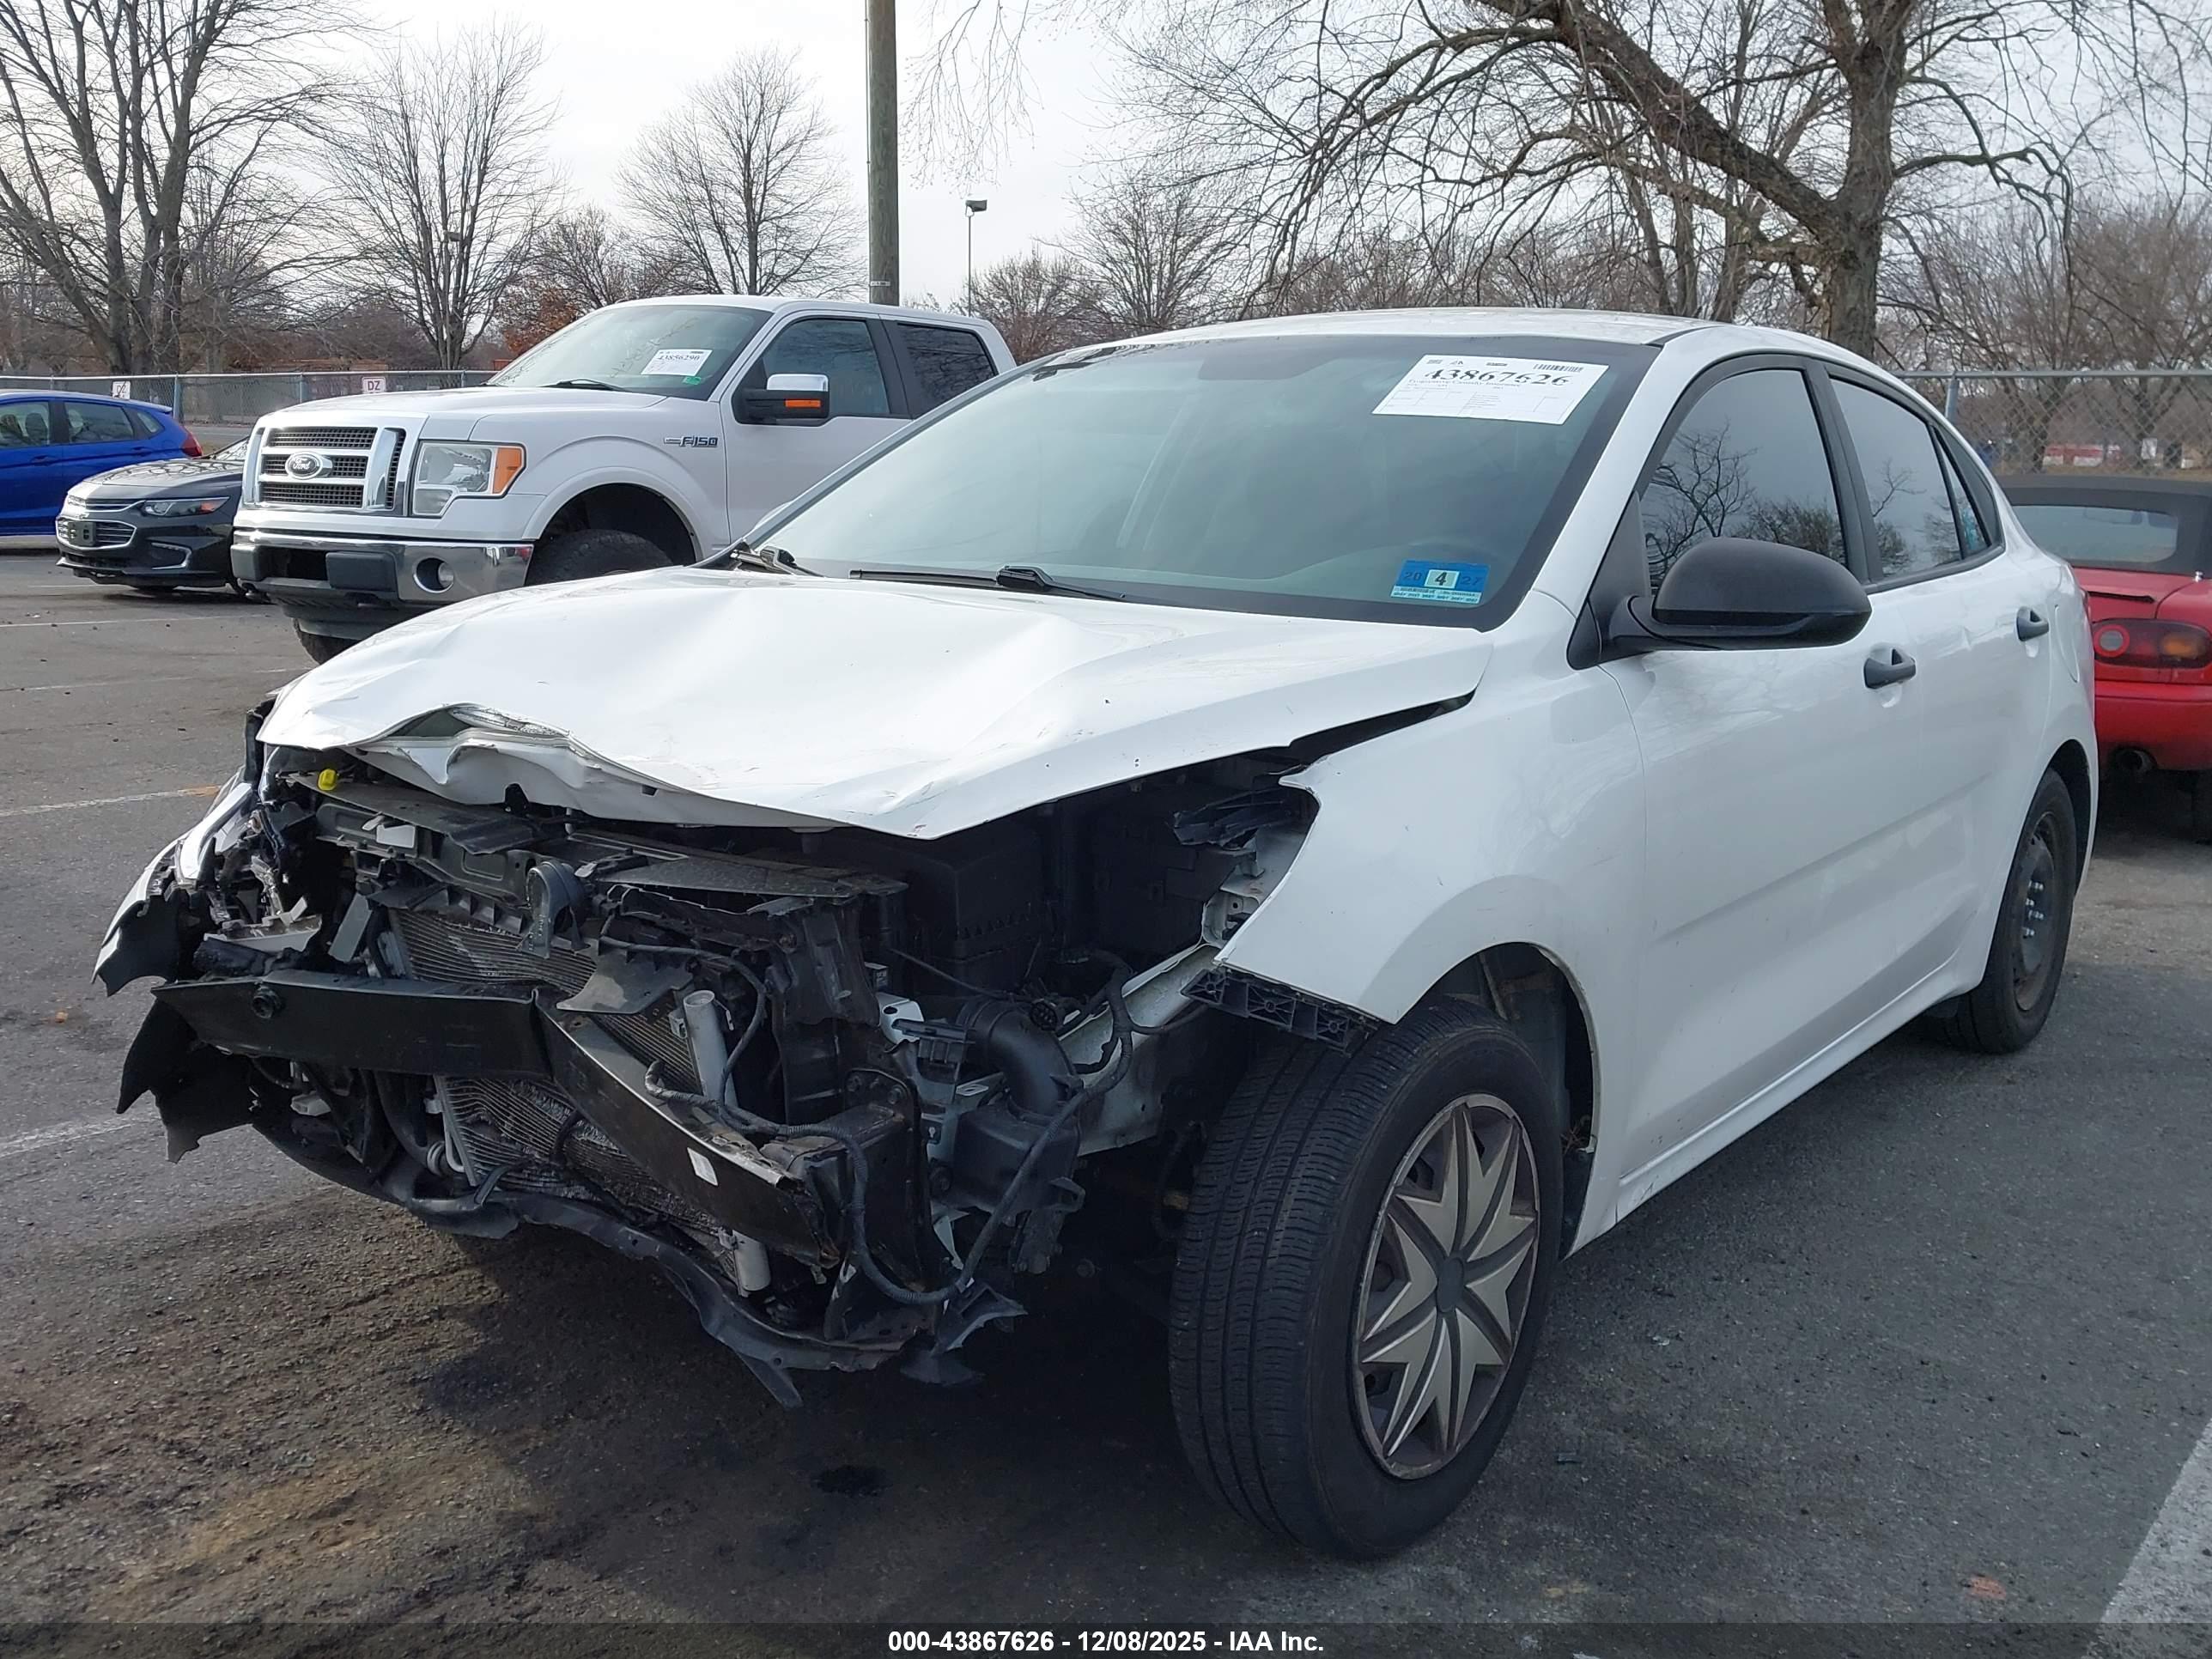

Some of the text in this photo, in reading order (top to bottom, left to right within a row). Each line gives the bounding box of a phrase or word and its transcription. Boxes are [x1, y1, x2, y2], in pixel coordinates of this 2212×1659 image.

[1425, 368, 1572, 386] 43867626
[293, 458, 312, 470] Ford
[1434, 571, 1448, 586] 4
